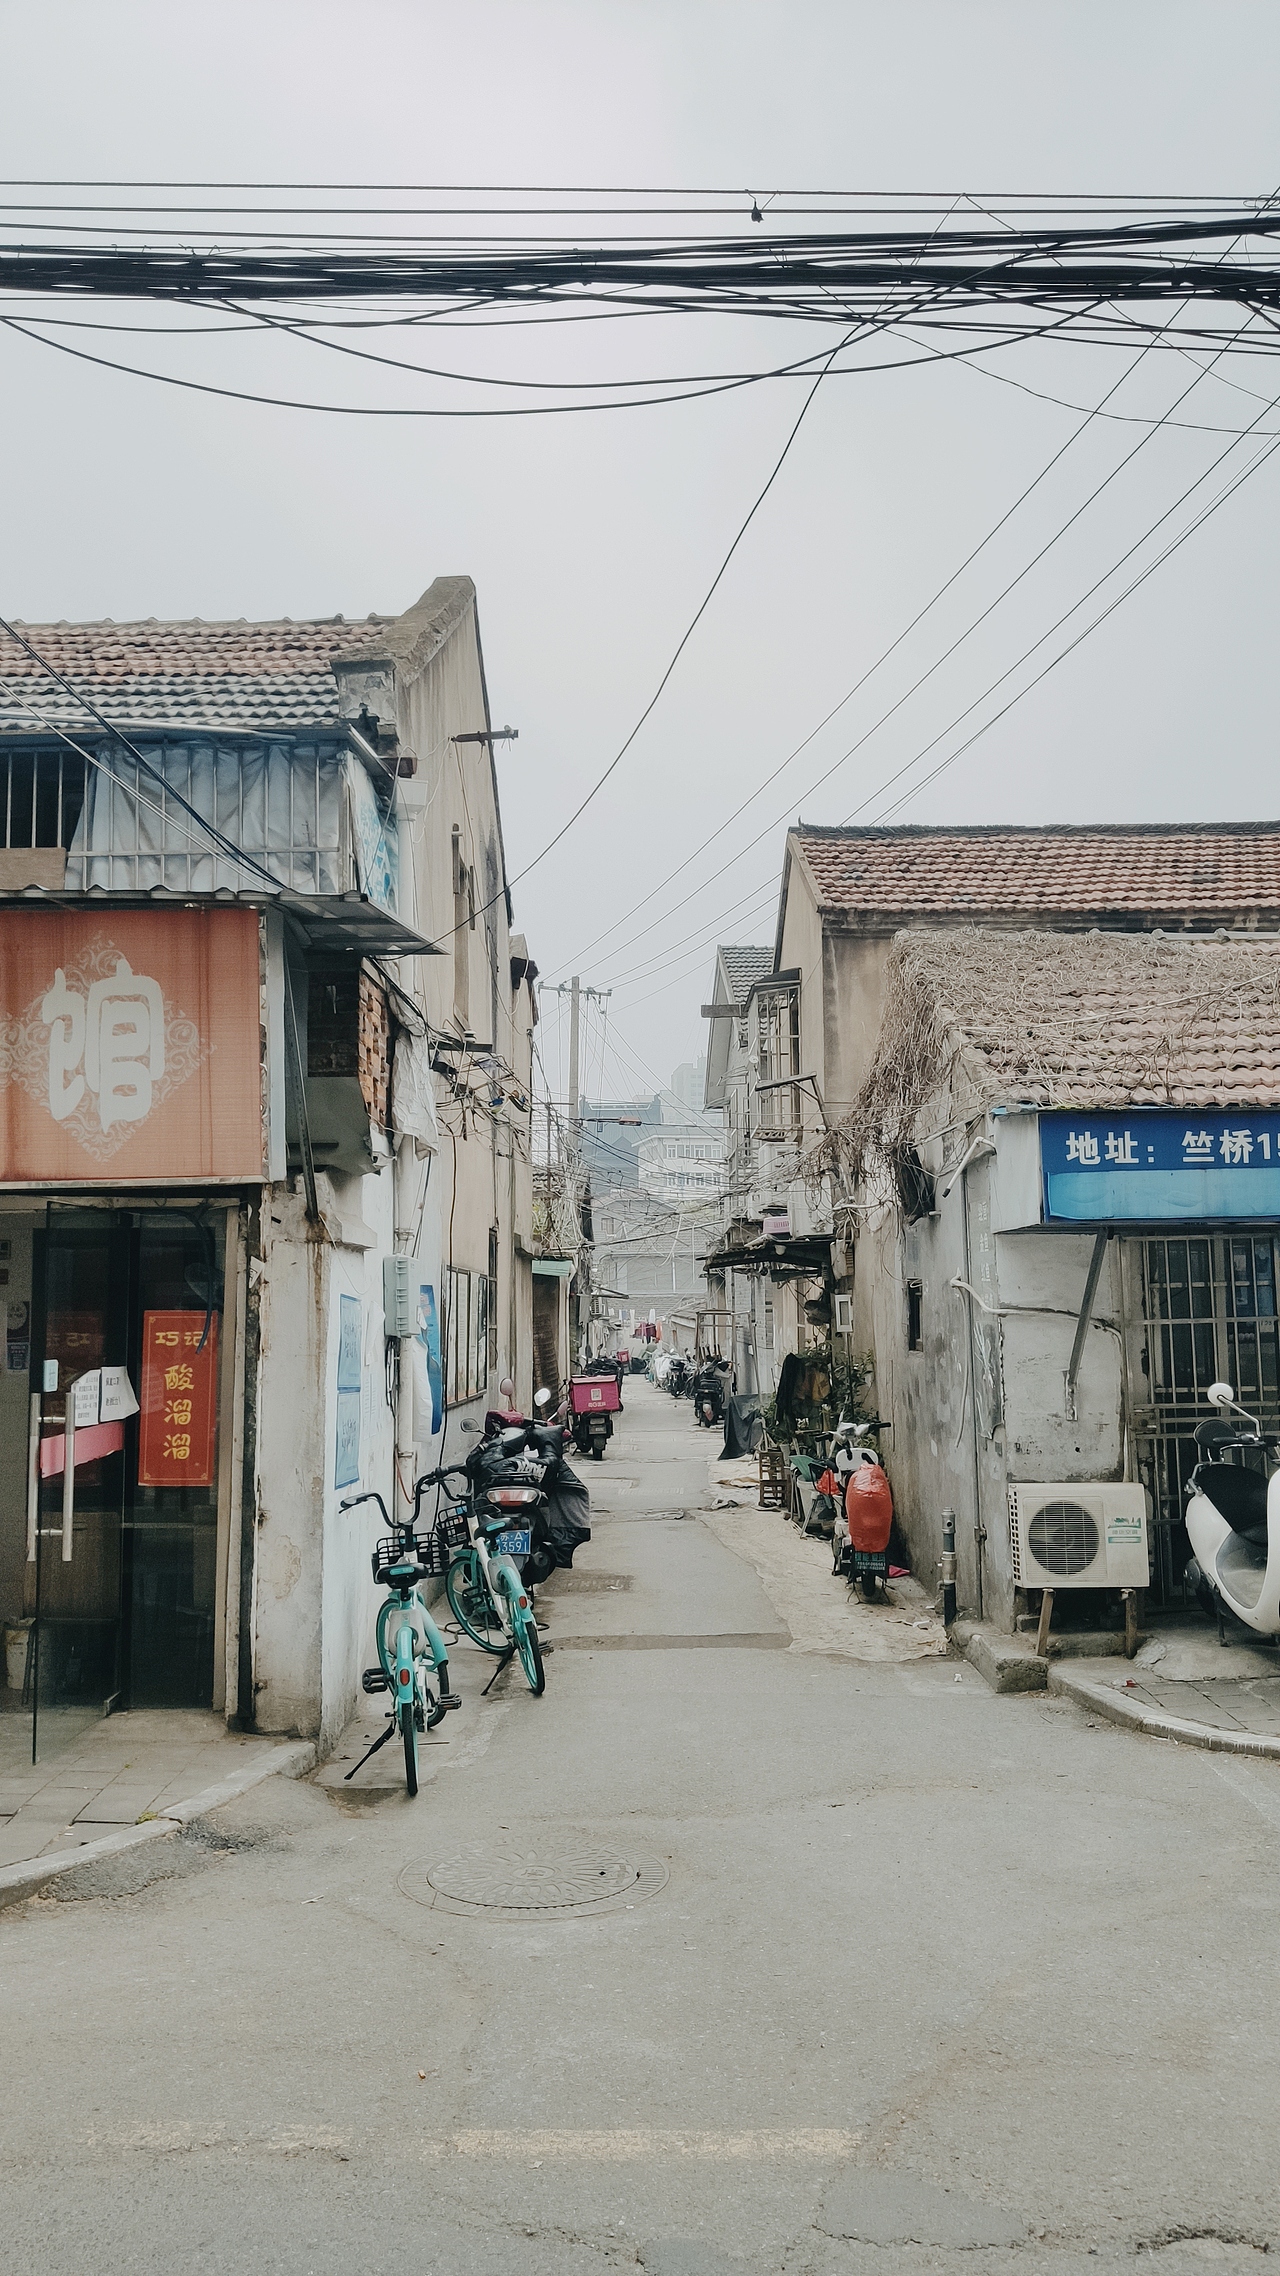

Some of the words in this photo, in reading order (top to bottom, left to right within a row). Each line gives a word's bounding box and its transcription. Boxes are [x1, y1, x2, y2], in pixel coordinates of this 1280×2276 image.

[43, 958, 165, 1133] 馆
[1065, 1129, 1280, 1165] 地址：竺桥1
[155, 1331, 208, 1347] 巧记
[163, 1363, 195, 1460] 酸溜溜
